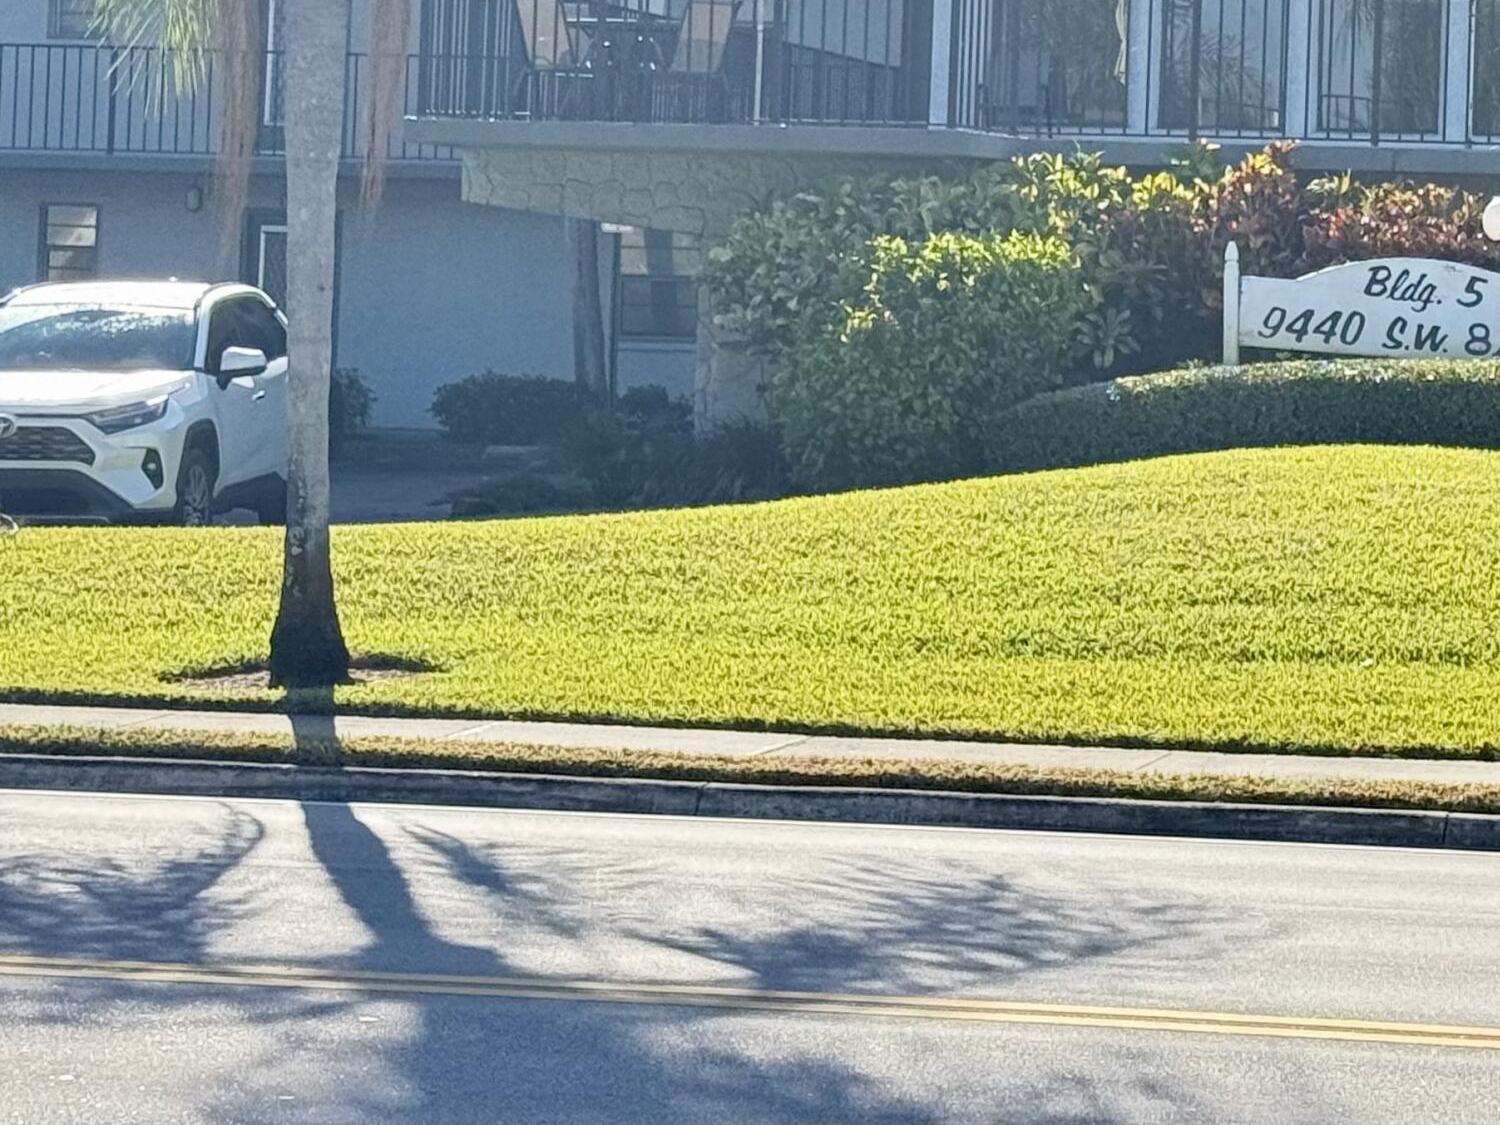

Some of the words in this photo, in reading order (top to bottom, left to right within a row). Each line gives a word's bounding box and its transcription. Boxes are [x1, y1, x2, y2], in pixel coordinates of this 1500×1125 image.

[1364, 266, 1442, 312] Bldg.
[1456, 276, 1488, 307] 5
[1258, 306, 1365, 345] 9440
[1381, 315, 1449, 353] S.W.
